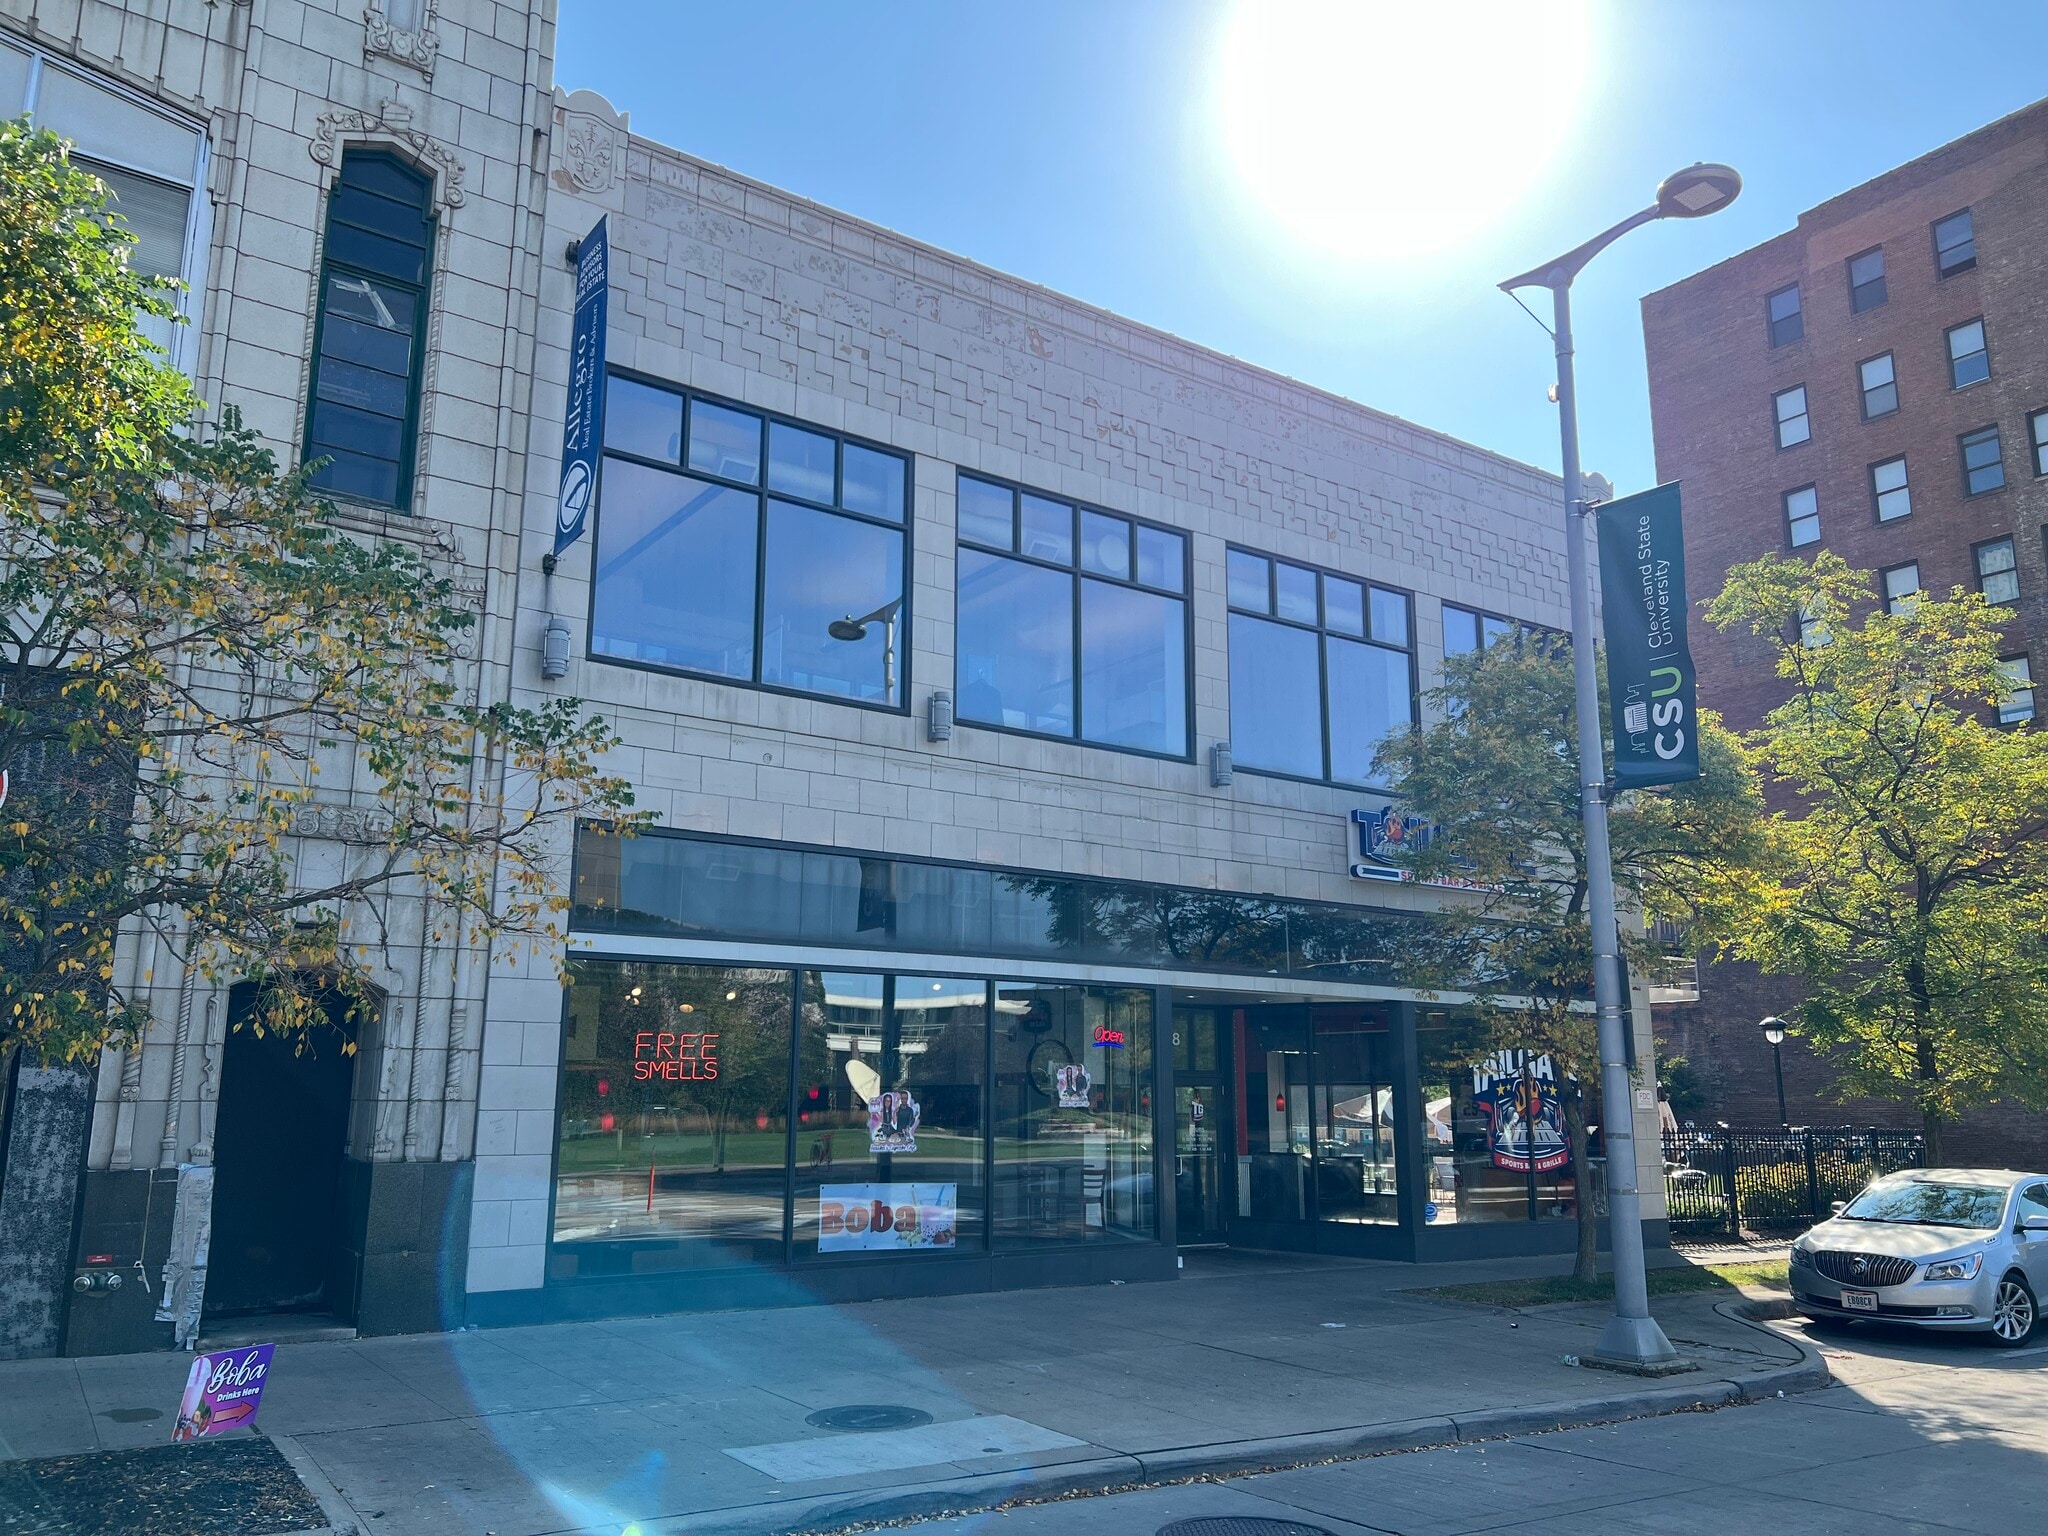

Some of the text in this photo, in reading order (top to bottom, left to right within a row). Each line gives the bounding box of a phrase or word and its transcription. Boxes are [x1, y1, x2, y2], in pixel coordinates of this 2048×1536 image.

[580, 251, 603, 280] ADVISORS
[581, 241, 602, 269] BUSINESS
[587, 270, 605, 291] ESTATE
[588, 262, 603, 280] YOUR
[590, 303, 598, 344] Advisors
[586, 357, 595, 395] Brokers
[566, 334, 588, 452] Allegro
[584, 395, 593, 425] Estate
[582, 426, 590, 449] Real
[1637, 515, 1661, 648] Cleveland State
[1655, 559, 1672, 646] University
[1651, 666, 1685, 760] CSU
[635, 1032, 719, 1060] FREE
[1095, 1026, 1124, 1042] Open
[634, 1061, 718, 1080] SMELLS
[1501, 1158, 1524, 1169] SPORTS
[1543, 1157, 1562, 1168] GRILLE
[821, 1200, 917, 1235] Boba
[207, 1351, 268, 1394] Boba
[216, 1387, 260, 1402] Drinks Here
